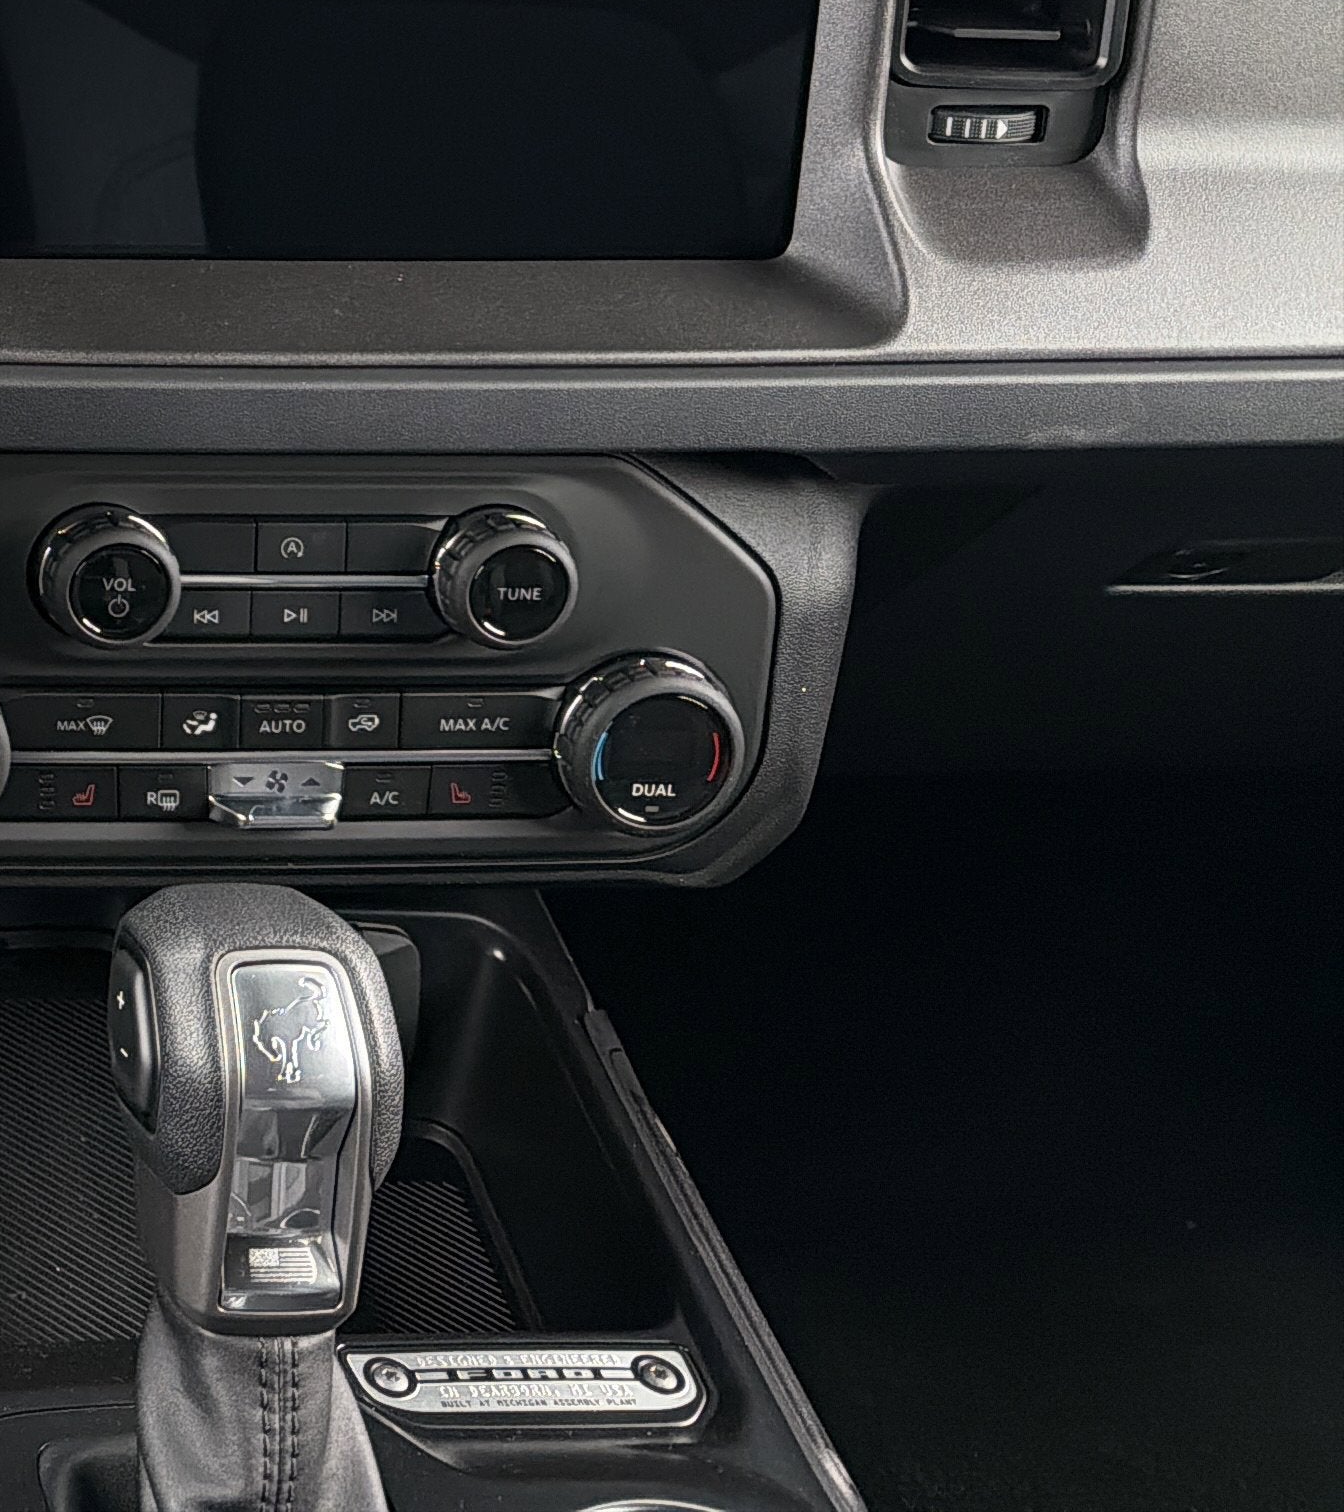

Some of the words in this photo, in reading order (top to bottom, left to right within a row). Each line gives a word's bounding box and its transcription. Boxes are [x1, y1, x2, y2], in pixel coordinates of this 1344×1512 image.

[103, 577, 137, 592] VOL
[497, 587, 542, 601] TUNE
[57, 720, 86, 732] MAX
[259, 719, 307, 734] AUTO
[439, 718, 476, 732] MAX
[480, 717, 511, 732] A/C
[631, 783, 677, 798] DUAL
[146, 792, 157, 806] R
[370, 791, 399, 806] A/C
[416, 1354, 497, 1367] DESIGNED
[456, 1368, 595, 1381] FORD
[569, 1383, 593, 1398] MI
[599, 1383, 634, 1398] USA
[440, 1400, 472, 1408] BUILT
[479, 1399, 491, 1407] AT
[497, 1398, 548, 1407] MICHIGAN
[553, 1398, 601, 1406] ASSEMBLY
[605, 1398, 637, 1406] PLANT
